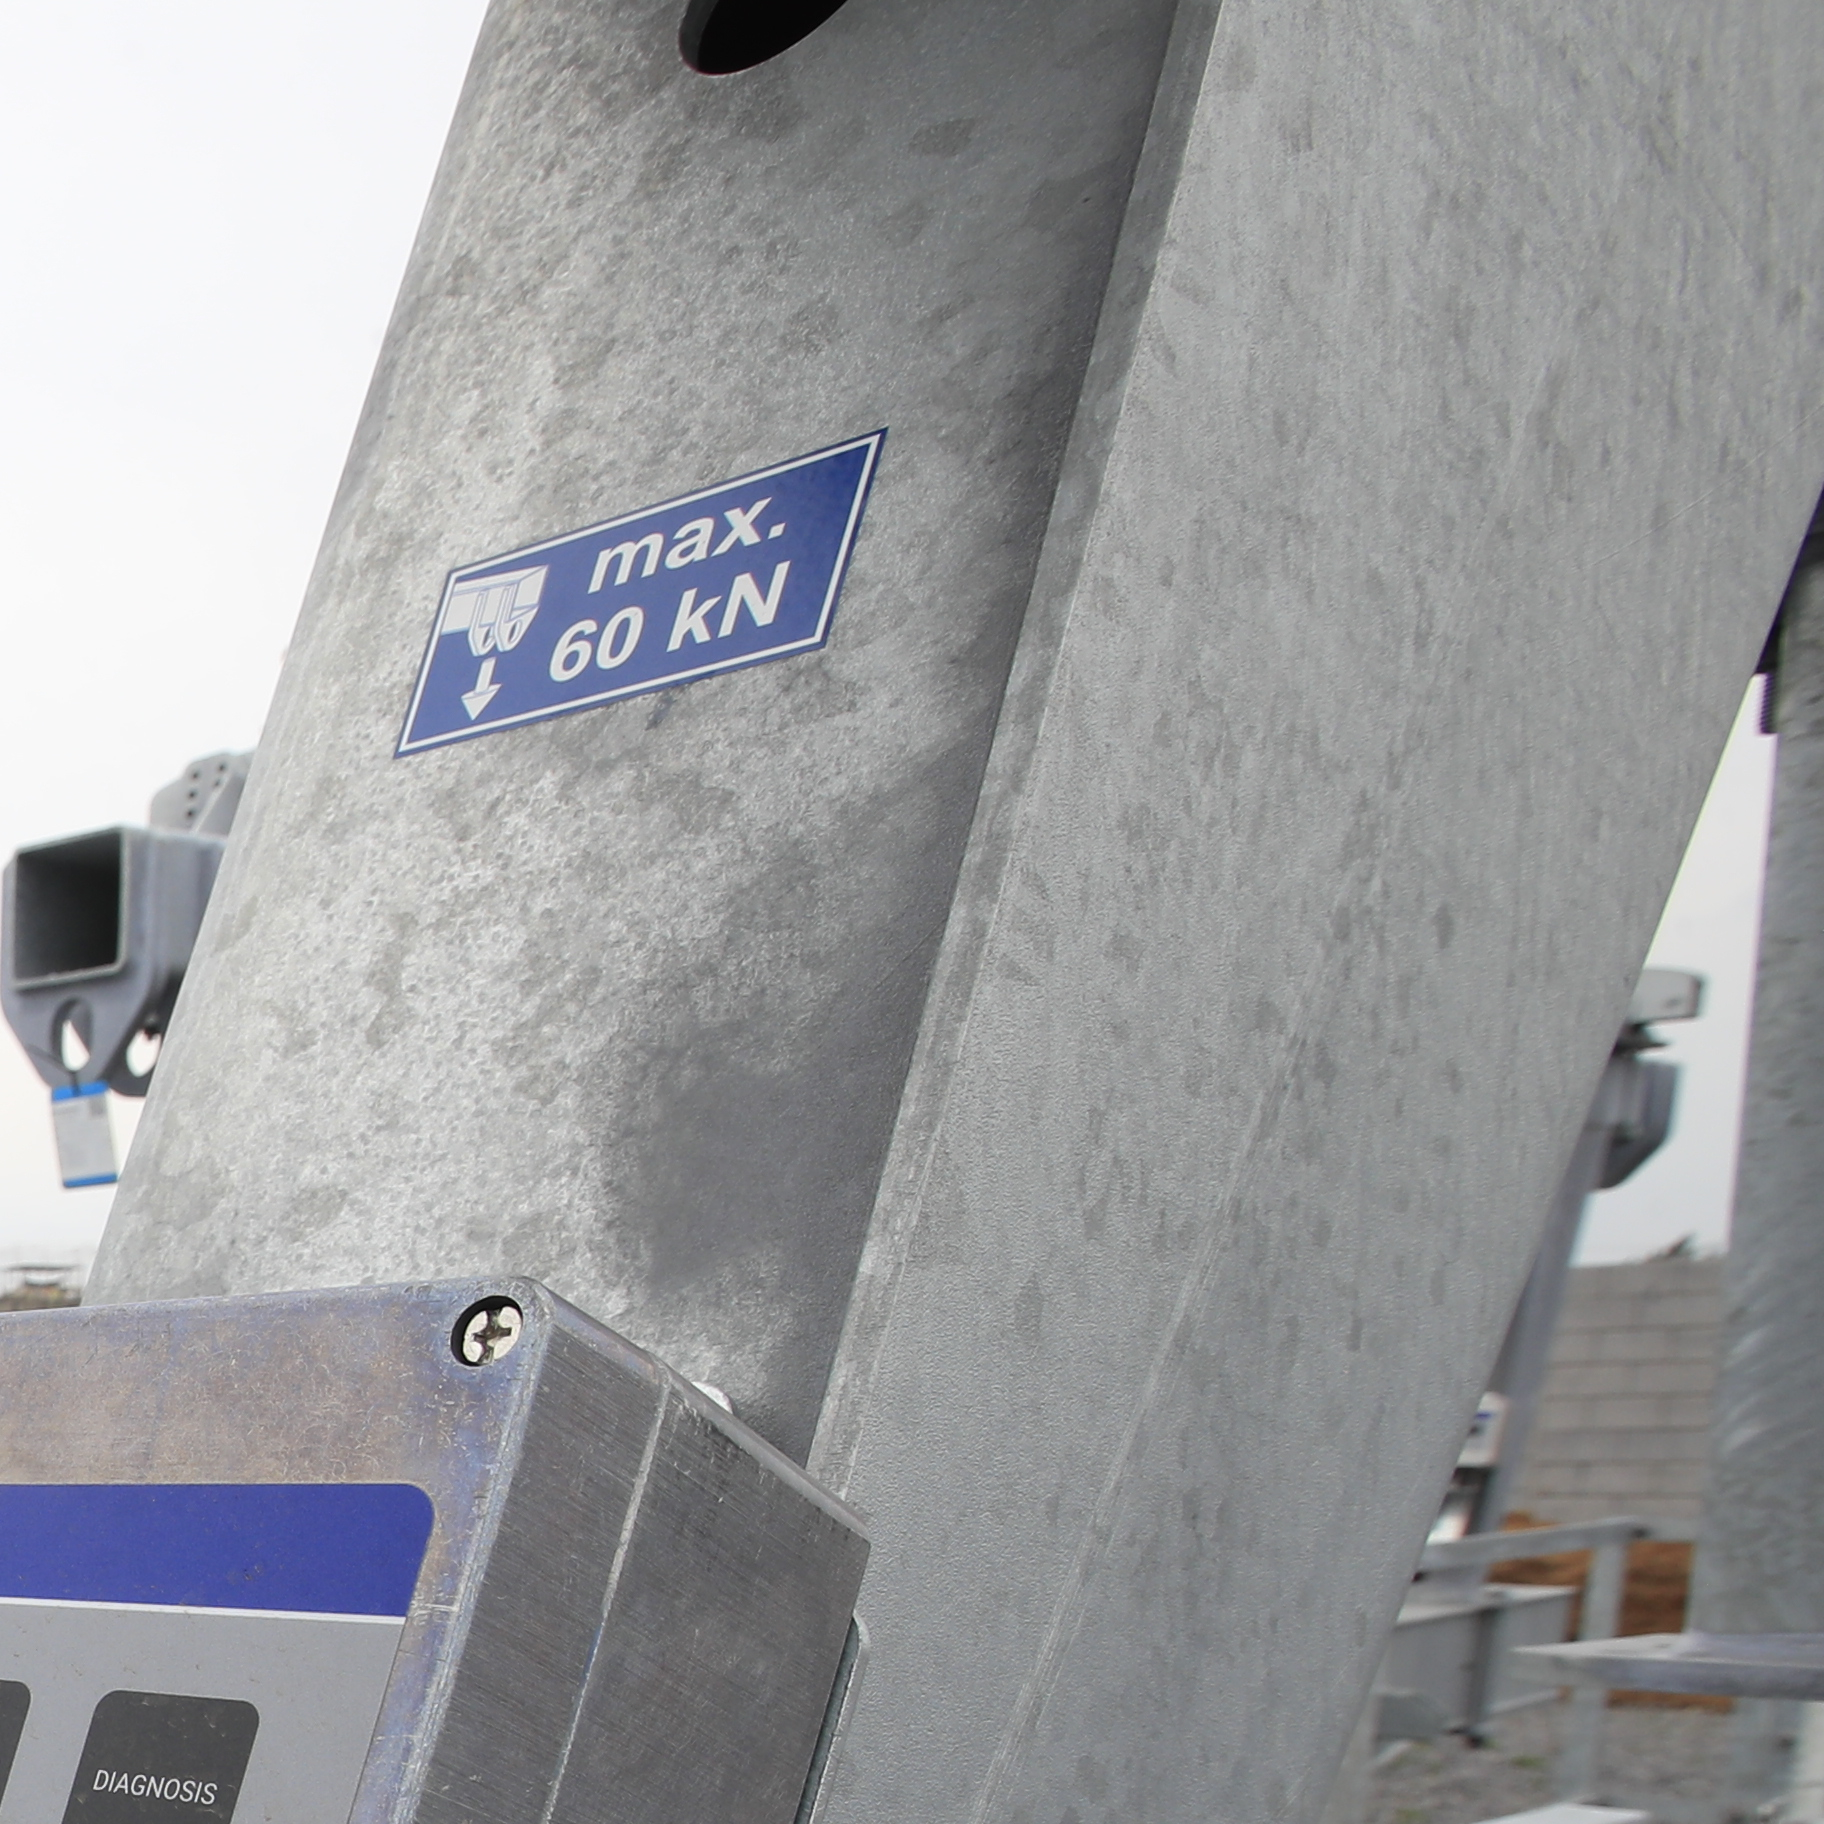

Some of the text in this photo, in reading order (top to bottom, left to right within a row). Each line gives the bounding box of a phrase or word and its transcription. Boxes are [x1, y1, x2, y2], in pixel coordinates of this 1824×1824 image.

[588, 497, 786, 594] max.
[549, 560, 792, 682] 60 kN
[92, 1769, 218, 1805] DIAGNOSIS
